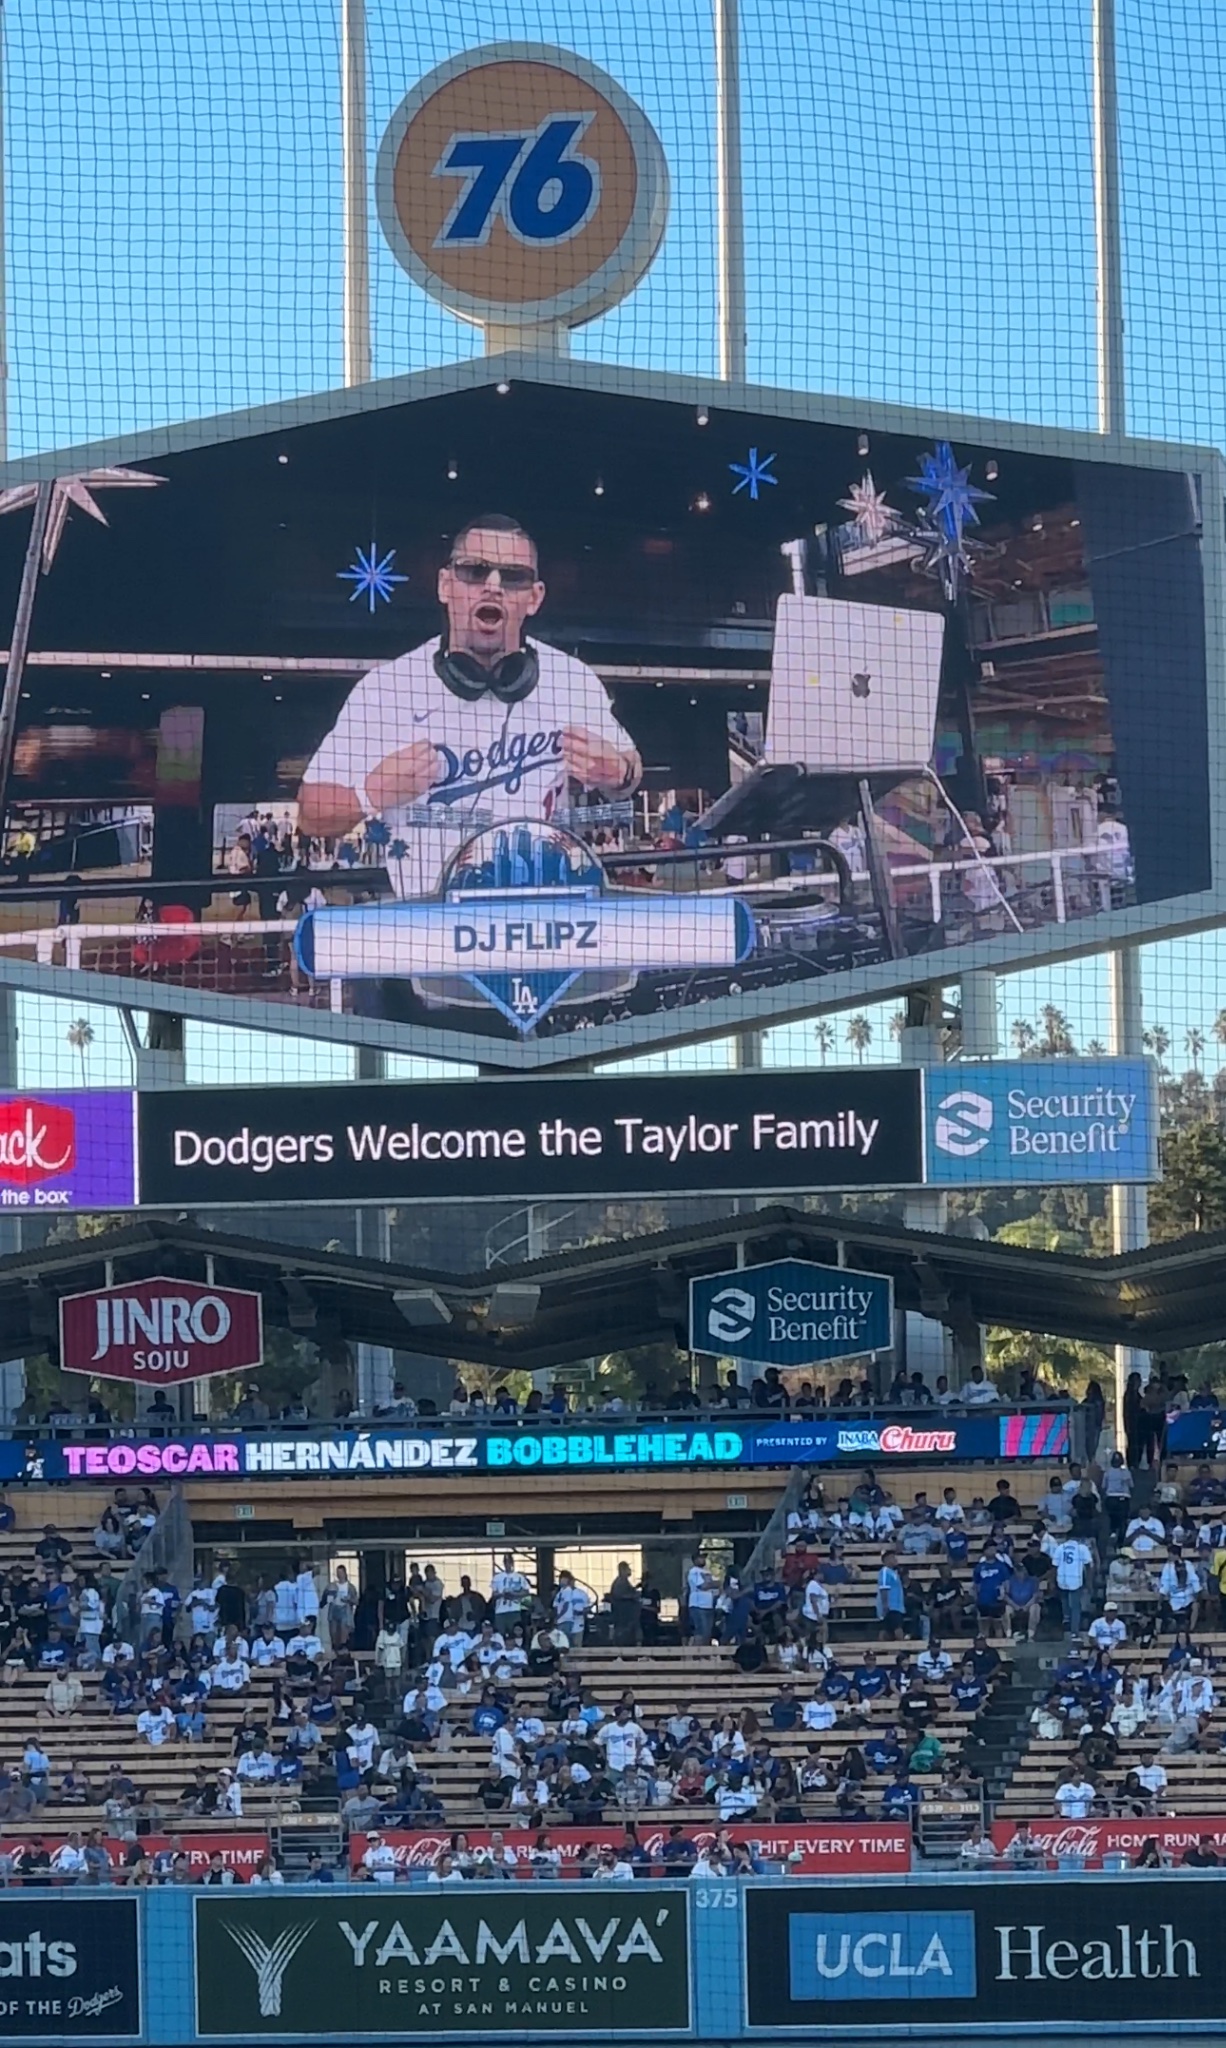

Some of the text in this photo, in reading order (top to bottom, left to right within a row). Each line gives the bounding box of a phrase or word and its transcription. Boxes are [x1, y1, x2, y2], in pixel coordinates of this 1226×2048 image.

[431, 111, 602, 249] 76
[427, 729, 563, 804] Dodger
[454, 921, 598, 953] DJ FLIPZ
[512, 977, 539, 1014] LA
[1008, 1087, 1136, 1123] Security
[173, 1110, 879, 1172] Dodgers Welcome the Taylor Family
[1009, 1122, 1120, 1155] Benefit
[0, 1188, 70, 1205] the box
[767, 1285, 873, 1316] Security
[91, 1295, 231, 1361] JINRO
[768, 1315, 860, 1342] Benefit
[133, 1350, 189, 1372] SOJU
[62, 1443, 240, 1475] TEOSCAR
[245, 1433, 478, 1472] HERNÁNDEZ
[486, 1432, 744, 1466] BOBBLEHEAD
[756, 1437, 813, 1447] PRESENTED
[815, 1436, 828, 1446] BY
[880, 1425, 956, 1452] Churu
[758, 1838, 906, 1855] HIT EVERY TIME
[1107, 1834, 1159, 1848] HOM
[1164, 1833, 1200, 1847] RUN
[695, 1888, 738, 1908] 375
[0, 1930, 78, 1978] ats
[815, 1923, 1201, 1981] UCLA Health
[25, 2000, 62, 2015] THE
[67, 1985, 123, 2018] Dodgers
[379, 1976, 628, 1994] RESORT & CASINO
[418, 2001, 589, 2015] AT SAN MANUEL
